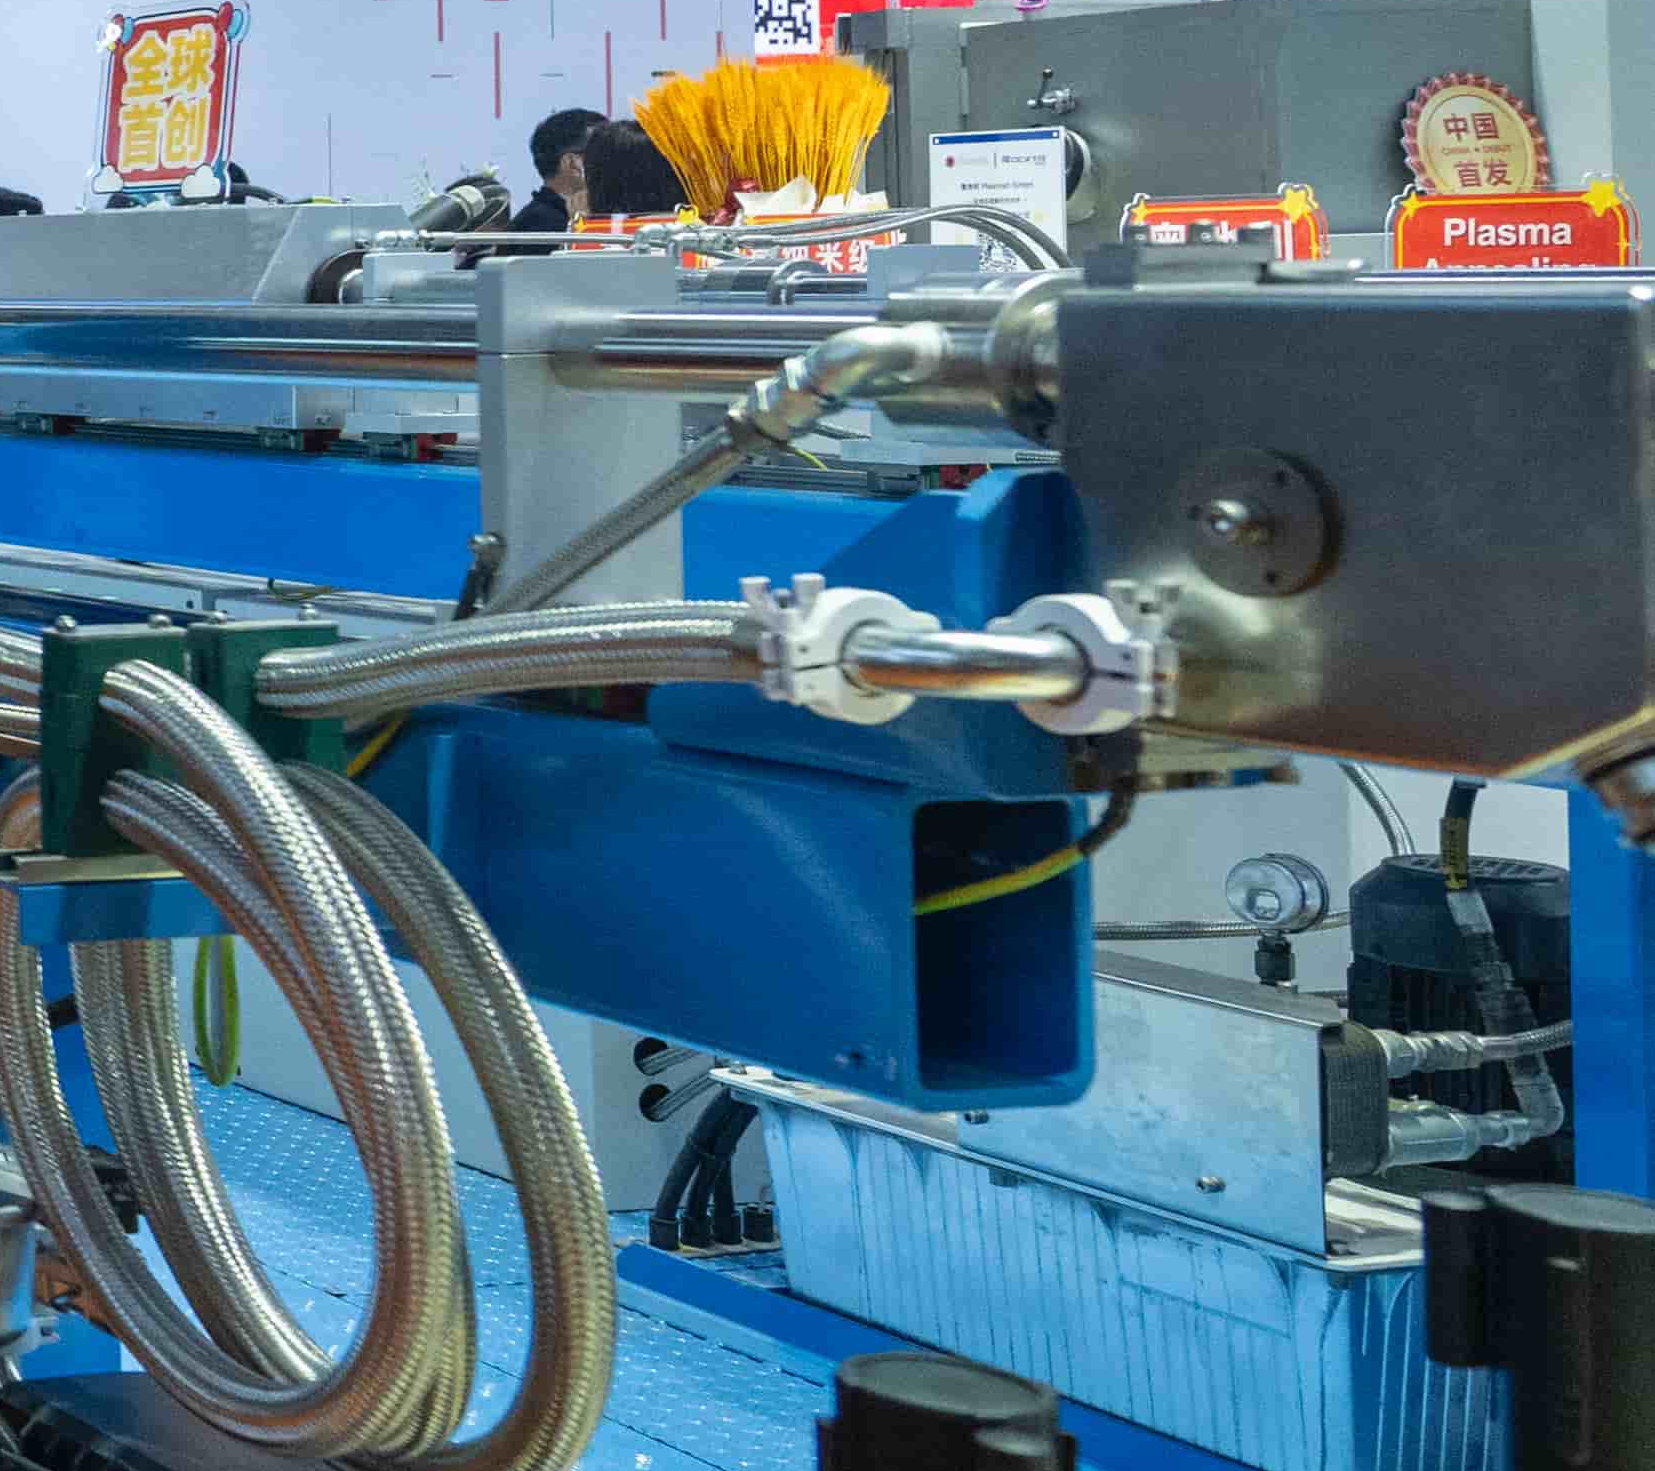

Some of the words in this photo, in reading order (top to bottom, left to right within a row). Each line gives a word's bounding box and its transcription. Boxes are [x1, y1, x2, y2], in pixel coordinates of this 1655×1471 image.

[124, 29, 215, 98] 全球
[119, 98, 213, 169] 首创
[1442, 112, 1500, 142] 中国
[1453, 159, 1513, 188] 首发
[1442, 217, 1573, 247] Plasma
